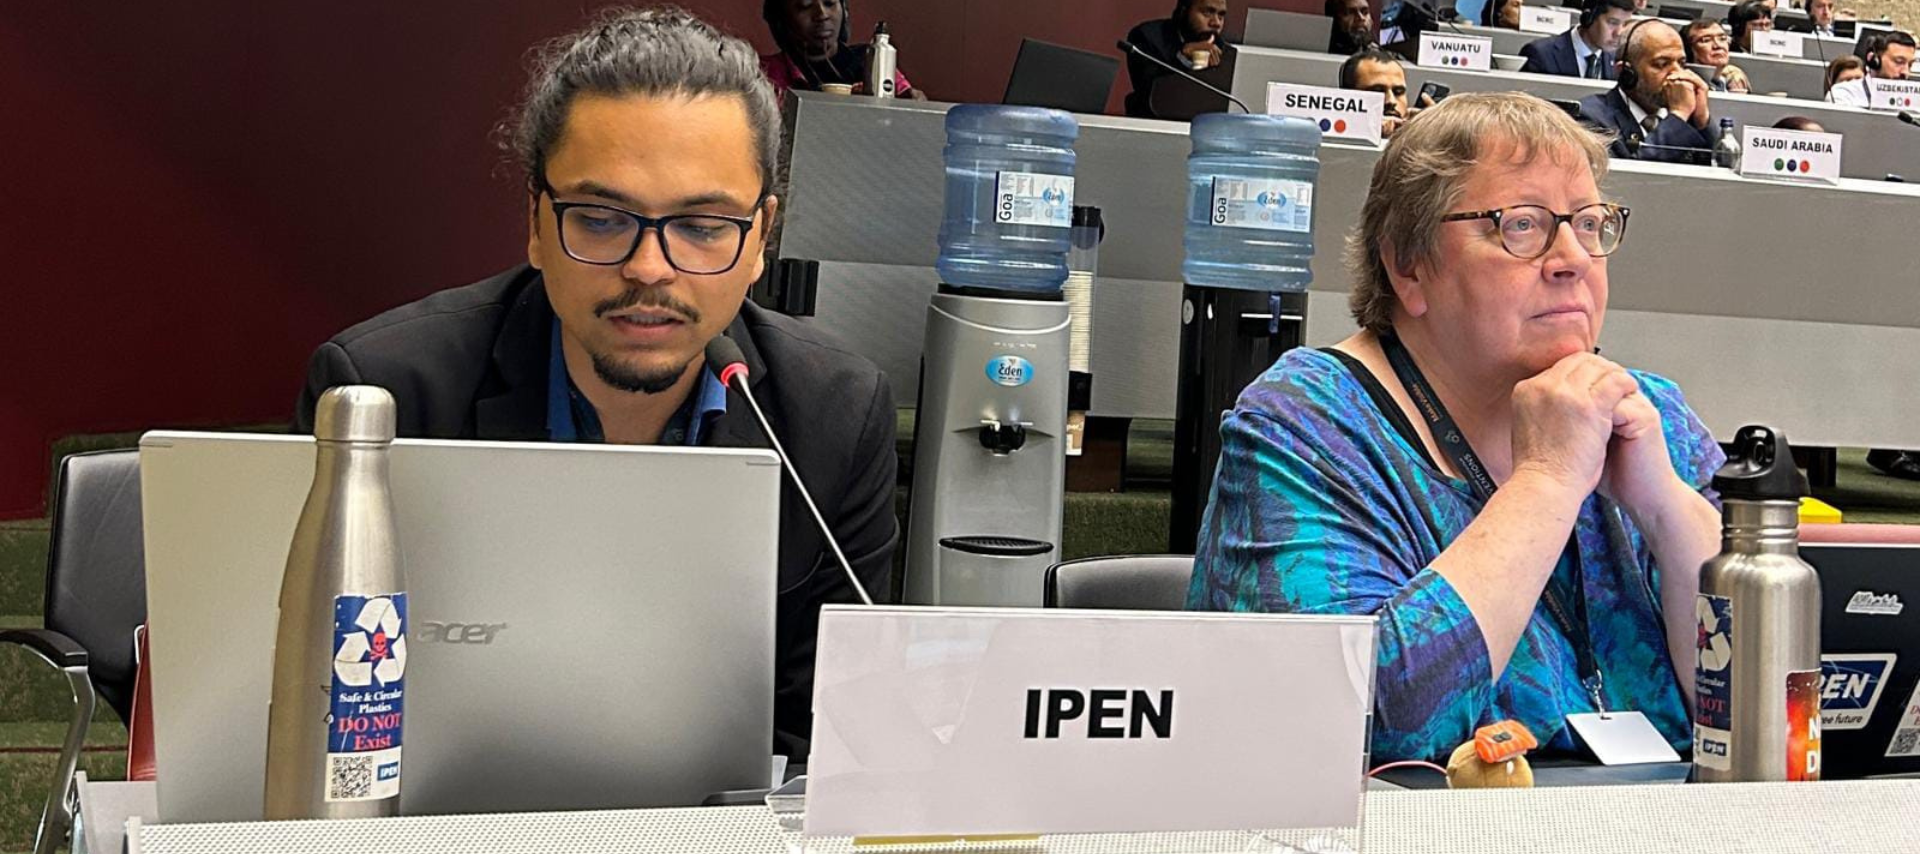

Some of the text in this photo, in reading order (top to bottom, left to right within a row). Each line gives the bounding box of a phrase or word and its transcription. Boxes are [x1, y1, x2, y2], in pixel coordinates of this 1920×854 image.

[1431, 40, 1481, 53] VANUATU
[1285, 94, 1368, 113] SENEGAL
[1752, 137, 1833, 154] SAUDI ARABIA
[999, 193, 1014, 221] Goa
[1214, 198, 1227, 223] Goa
[998, 363, 1022, 378] Eden
[417, 621, 507, 645] acer
[339, 692, 363, 703] Safe
[364, 691, 373, 702] &
[359, 703, 392, 714] Plastics
[1024, 689, 1174, 738] IPEN
[338, 713, 402, 733] DO NOT
[1835, 713, 1864, 724] future
[354, 733, 391, 750] Exist
